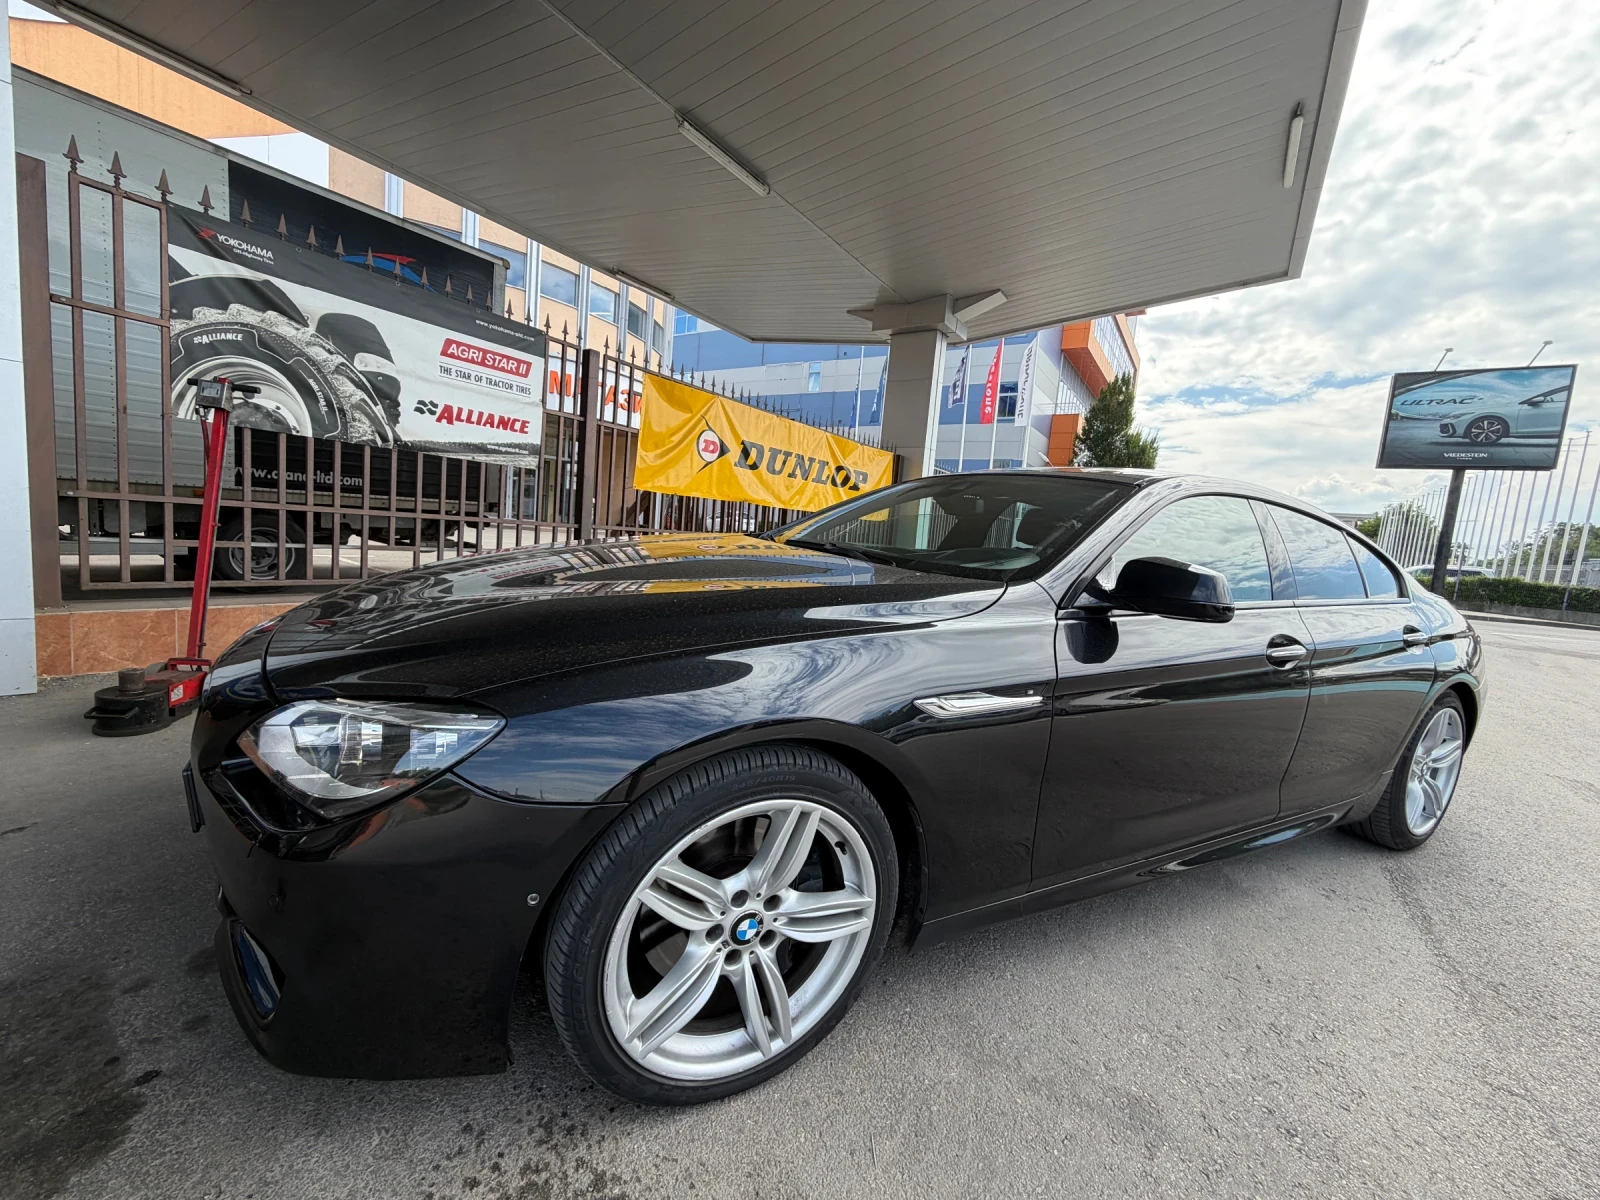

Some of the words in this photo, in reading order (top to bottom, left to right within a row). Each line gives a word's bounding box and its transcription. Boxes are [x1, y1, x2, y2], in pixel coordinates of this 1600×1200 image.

[216, 233, 274, 259] YOKOHAMA
[233, 248, 263, 262] Off-Highway
[202, 332, 243, 344] ALLIANCE
[447, 343, 483, 363] AGRI
[485, 353, 517, 372] STAR
[518, 363, 527, 375] II
[439, 365, 453, 376] THE
[455, 369, 472, 381] STAR
[474, 374, 483, 384] OF
[485, 376, 514, 391] TRACTOR
[515, 384, 531, 396] TIRES
[435, 403, 531, 435] ALLIANCE
[734, 439, 868, 492] DUNLOP
